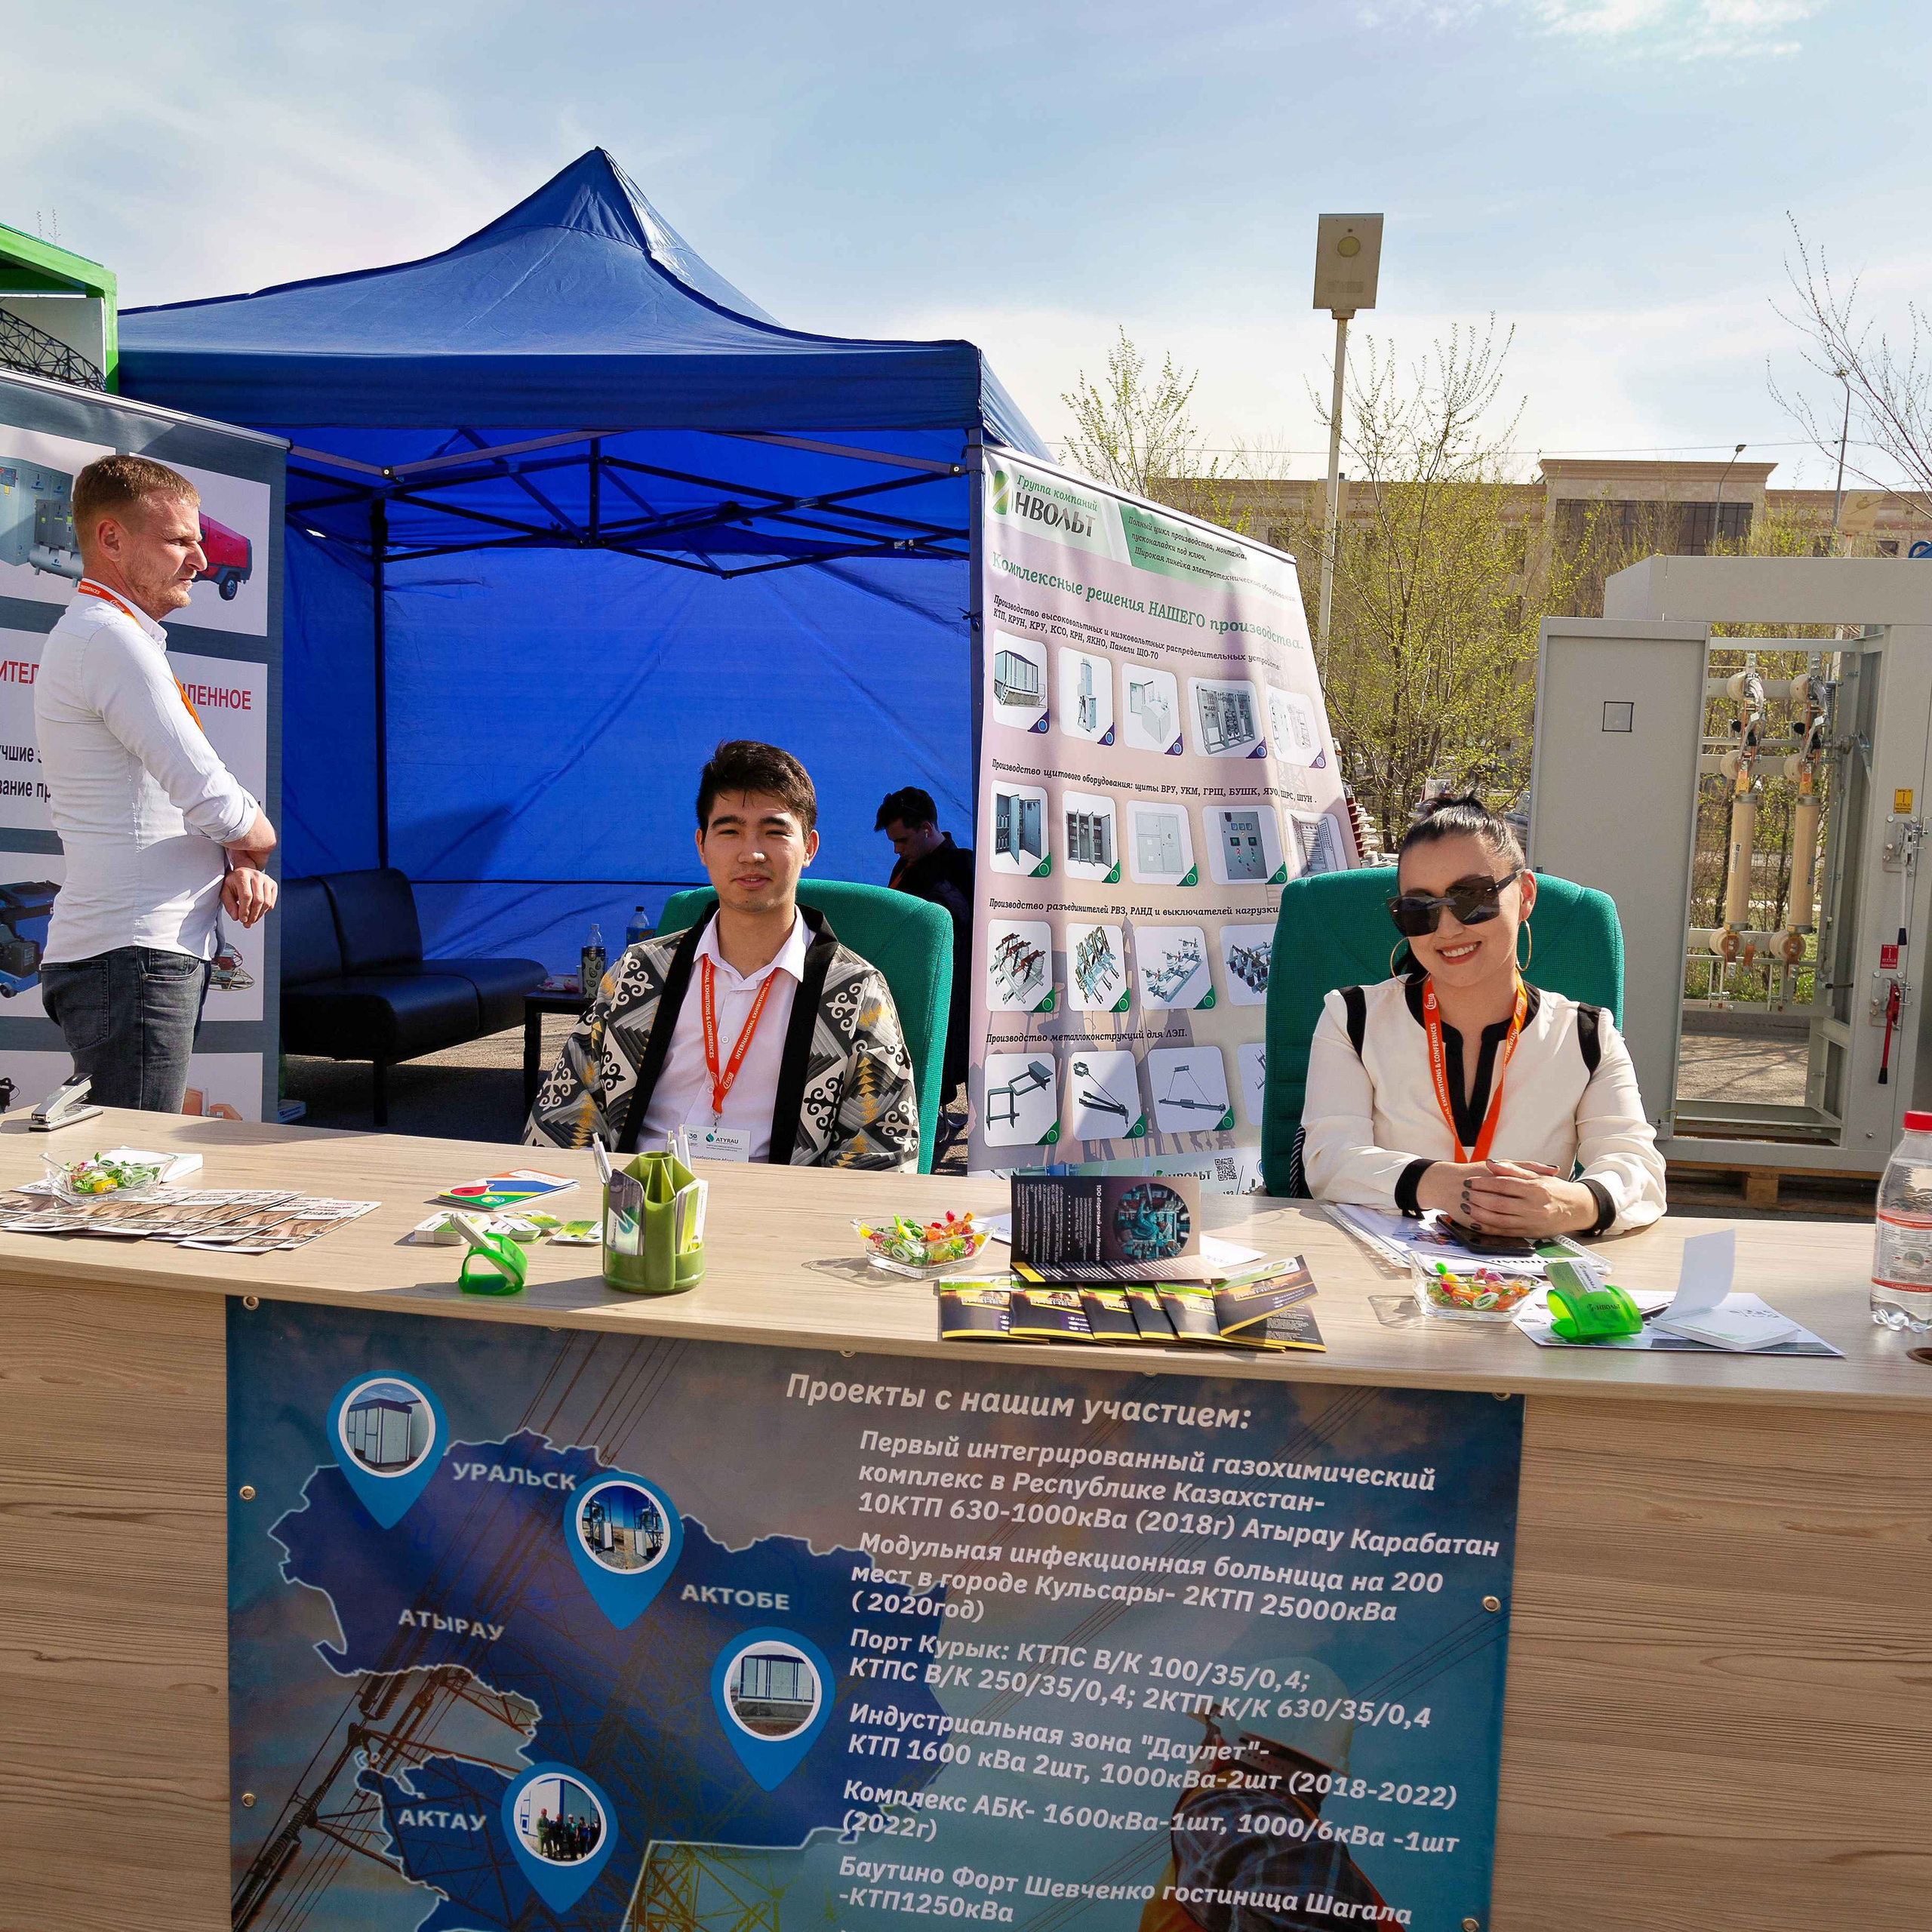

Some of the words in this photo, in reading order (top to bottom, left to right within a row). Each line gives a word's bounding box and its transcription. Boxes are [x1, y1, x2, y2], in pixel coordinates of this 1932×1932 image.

[1017, 475, 1051, 495] Группа
[1054, 490, 1098, 512] компаний
[1128, 515, 1152, 531] Полный
[1153, 526, 1171, 537] цикл
[1171, 531, 1215, 552] производства,
[1216, 546, 1247, 561] монтажа,
[1131, 533, 1176, 552] пусконаладки
[1177, 546, 1187, 556] под
[1188, 552, 1207, 561] ключ.
[1134, 547, 1164, 563] Широкая
[1165, 558, 1191, 571] линейка
[992, 552, 1083, 595] Комплексные
[1085, 587, 1145, 613] решения
[1148, 601, 1205, 628] НАШЕГО
[1210, 620, 1304, 649] производства.
[993, 595, 1039, 617] Производство
[1041, 612, 1103, 635] высоковольтных
[1110, 631, 1165, 650] низковольтных
[1166, 644, 1246, 661] распределительных
[993, 608, 1008, 623] КТП,
[1008, 615, 1027, 629] КРУН,
[1029, 620, 1048, 635] КРУ,
[1049, 624, 1069, 639] КСО,
[1069, 629, 1085, 644] КРН,
[1085, 635, 1108, 650] ЯКНО,
[1109, 640, 1136, 655] Панели
[1136, 647, 1159, 660] ЩО-70
[0, 745, 35, 762] чшие
[992, 758, 1041, 776] Производство
[1043, 769, 1081, 782] щитового
[1082, 774, 1134, 789] оборудования:
[1134, 783, 1159, 792] щиты
[1160, 784, 1179, 796] ВРУ,
[1180, 786, 1201, 798] УКМ,
[1202, 787, 1226, 798] ГРЩ,
[989, 897, 1044, 910] Производство
[1045, 903, 1109, 915] разъединителей
[1109, 905, 1128, 917] РВЗ,
[1129, 906, 1153, 918] РЛНД
[1162, 906, 1233, 916] выключателей
[1235, 906, 1280, 916] нагрузки
[706, 1021, 715, 1059] CONFERENCES
[734, 1019, 755, 1060] INTERNATIONAL
[752, 986, 768, 1019] EXHIBITIONS
[985, 1032, 1048, 1044] Производство
[1048, 1031, 1145, 1042] металлоконструкций
[1145, 1029, 1165, 1041] для
[1165, 1029, 1188, 1038] ЛЭП.
[1430, 1022, 1440, 1063] CONFERENCES
[1435, 1069, 1447, 1107] EXHIBITIONS
[787, 1373, 926, 1408] Проекты
[934, 1389, 952, 1411] с
[960, 1392, 1075, 1417] нашим
[1081, 1399, 1251, 1429] участием:
[452, 1461, 577, 1491] УРАЛЬСК
[860, 1429, 960, 1458] Первый
[967, 1442, 1205, 1473] интегрированный
[1211, 1458, 1435, 1491] газохимический
[858, 1465, 983, 1489] комплекс
[989, 1475, 1005, 1491] в
[1012, 1472, 1167, 1501] Республике
[1173, 1481, 1325, 1512] Казахстан-
[858, 1492, 943, 1518] 10КТП
[949, 1499, 1128, 1530] 630-1000кВа
[1136, 1509, 1235, 1540] (2018г)
[1241, 1518, 1345, 1552] Атырау
[1349, 1528, 1500, 1557] Карабатан
[857, 1532, 1003, 1561] Модульная
[1010, 1544, 1207, 1575] инфекционная
[1214, 1555, 1344, 1592] больница
[1350, 1575, 1385, 1592] на
[1390, 1571, 1444, 1593] 200
[681, 1583, 790, 1611] АКТОБЕ
[851, 1564, 912, 1586] мест
[918, 1572, 933, 1588] в
[939, 1576, 1029, 1596] городе
[1035, 1575, 1177, 1606] Кульсары-
[1183, 1585, 1255, 1613] 2КТП
[1260, 1593, 1398, 1622] 25000кВа
[398, 1608, 505, 1642] АТЫРАУ
[850, 1628, 912, 1654] Порт
[918, 1634, 1010, 1660] Курык:
[1017, 1642, 1088, 1667] КТПС
[1093, 1649, 1143, 1675] В/К
[1149, 1656, 1310, 1693] 100/35/0,4;
[849, 1657, 918, 1682] КТПС
[924, 1664, 974, 1689] В/К
[978, 1669, 1138, 1707] 250/35/0,4;
[1143, 1687, 1214, 1715] 2КТП
[1220, 1696, 1272, 1720] К/К
[1277, 1698, 1432, 1730] 630/35/0,4
[849, 1703, 1064, 1746] Индустриальная
[1069, 1731, 1132, 1755] зона
[1141, 1734, 1271, 1761] "Даулет"-
[848, 1734, 900, 1758] КТП
[906, 1740, 971, 1764] 1600
[977, 1749, 1026, 1773] кВа
[1032, 1754, 1091, 1784] 2шт,
[1100, 1763, 1282, 1790] 1000кВа-2шт
[1288, 1770, 1457, 1810] (2018-2022)
[398, 1807, 487, 1832] АКТАУ
[841, 1809, 937, 1843] (2022г)
[843, 1779, 968, 1813] Комплекс
[972, 1795, 1035, 1820] АБК-
[1043, 1803, 1227, 1835] 1600кВа-1шт,
[1237, 1814, 1386, 1847] 1000/6кВа
[1393, 1831, 1460, 1853] -1шт
[839, 1855, 945, 1884] Баутино
[952, 1866, 1019, 1895] Форт
[1024, 1875, 1155, 1900] Шевченко
[1162, 1885, 1299, 1913] гостиница
[1305, 1893, 1412, 1925] Шагала
[839, 1887, 1014, 1923] -КТП1250кВа
